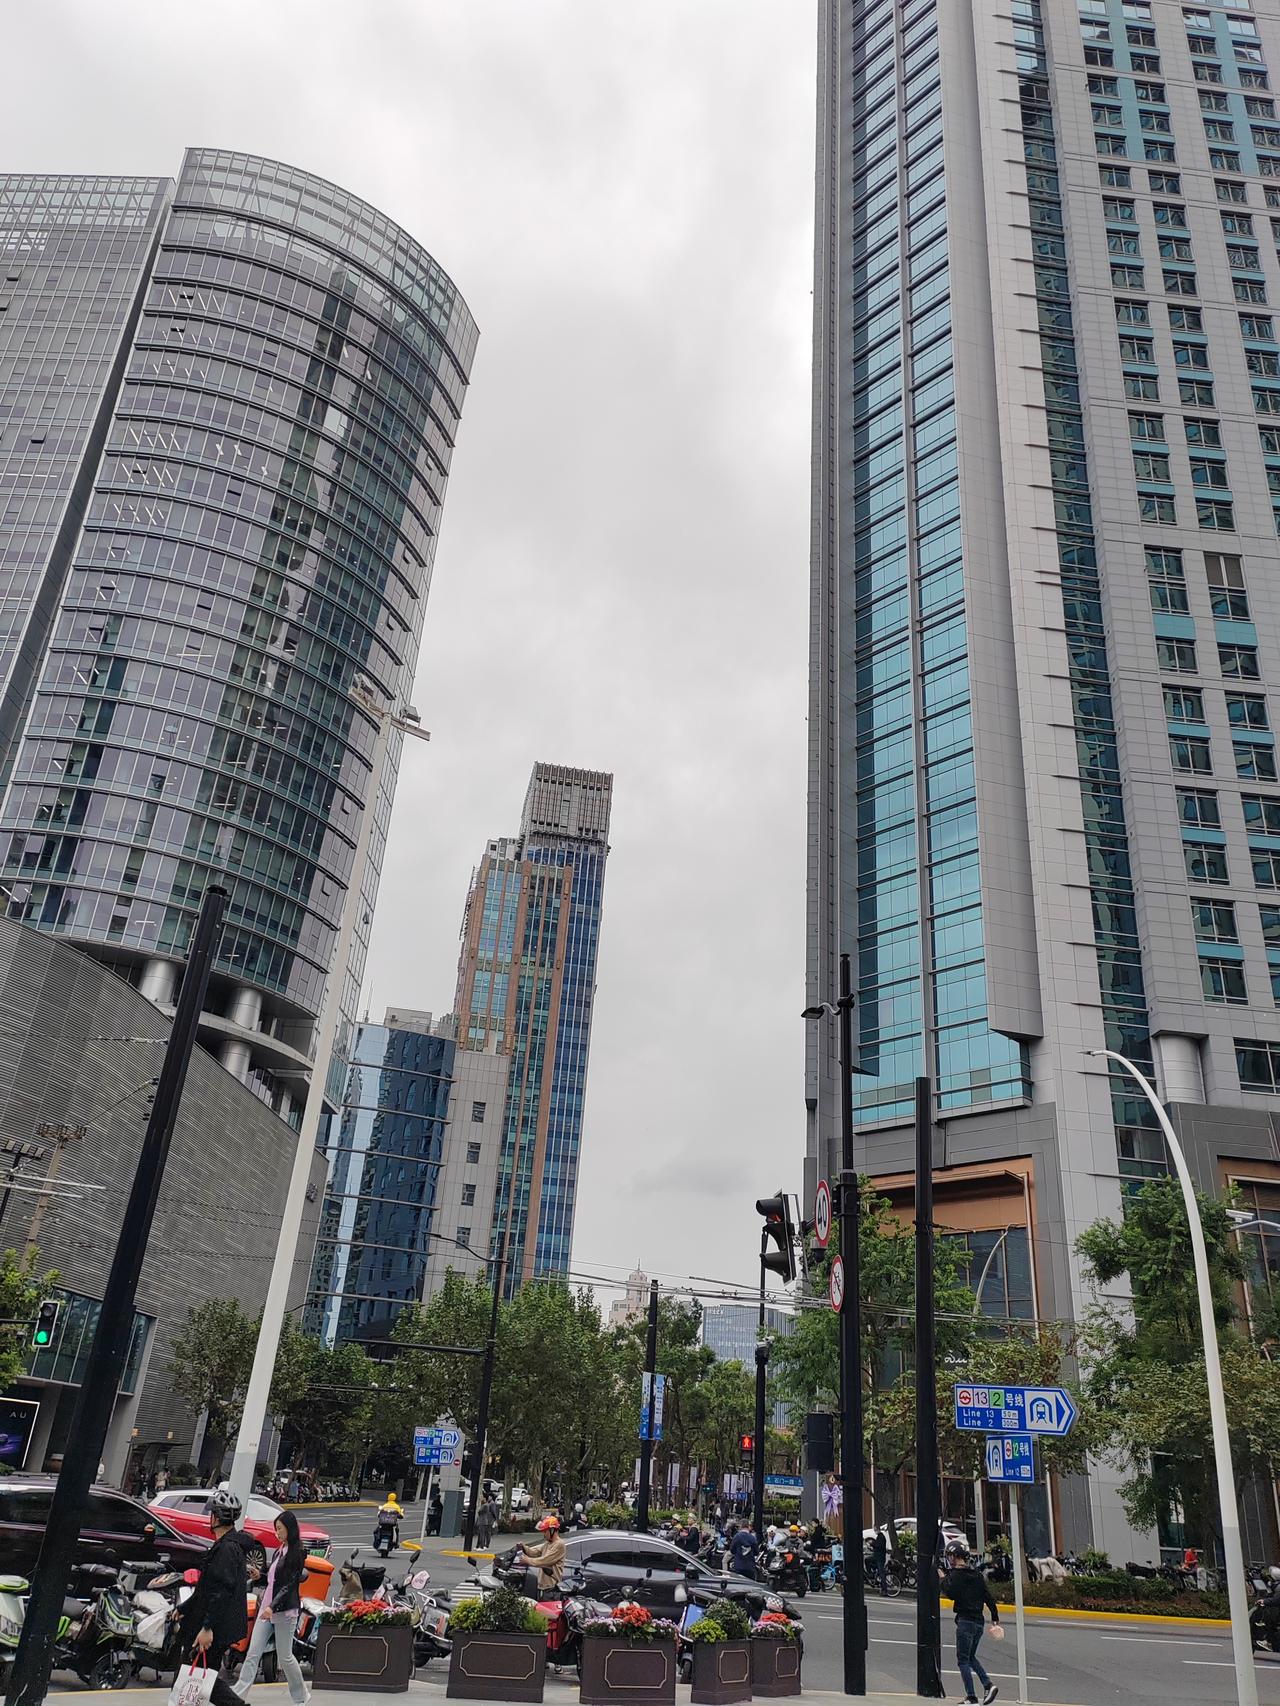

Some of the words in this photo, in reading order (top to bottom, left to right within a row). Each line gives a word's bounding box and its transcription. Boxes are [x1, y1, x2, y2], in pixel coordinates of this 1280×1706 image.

[818, 1194, 827, 1230] 40
[975, 1392, 988, 1405] 13
[992, 1392, 1002, 1407] 2
[1006, 1393, 1024, 1407] 号线
[963, 1409, 981, 1417] Line
[964, 1418, 981, 1426] Line
[988, 1418, 994, 1427] 2
[1013, 1442, 1019, 1456] 12
[1020, 1442, 1029, 1456] 号线
